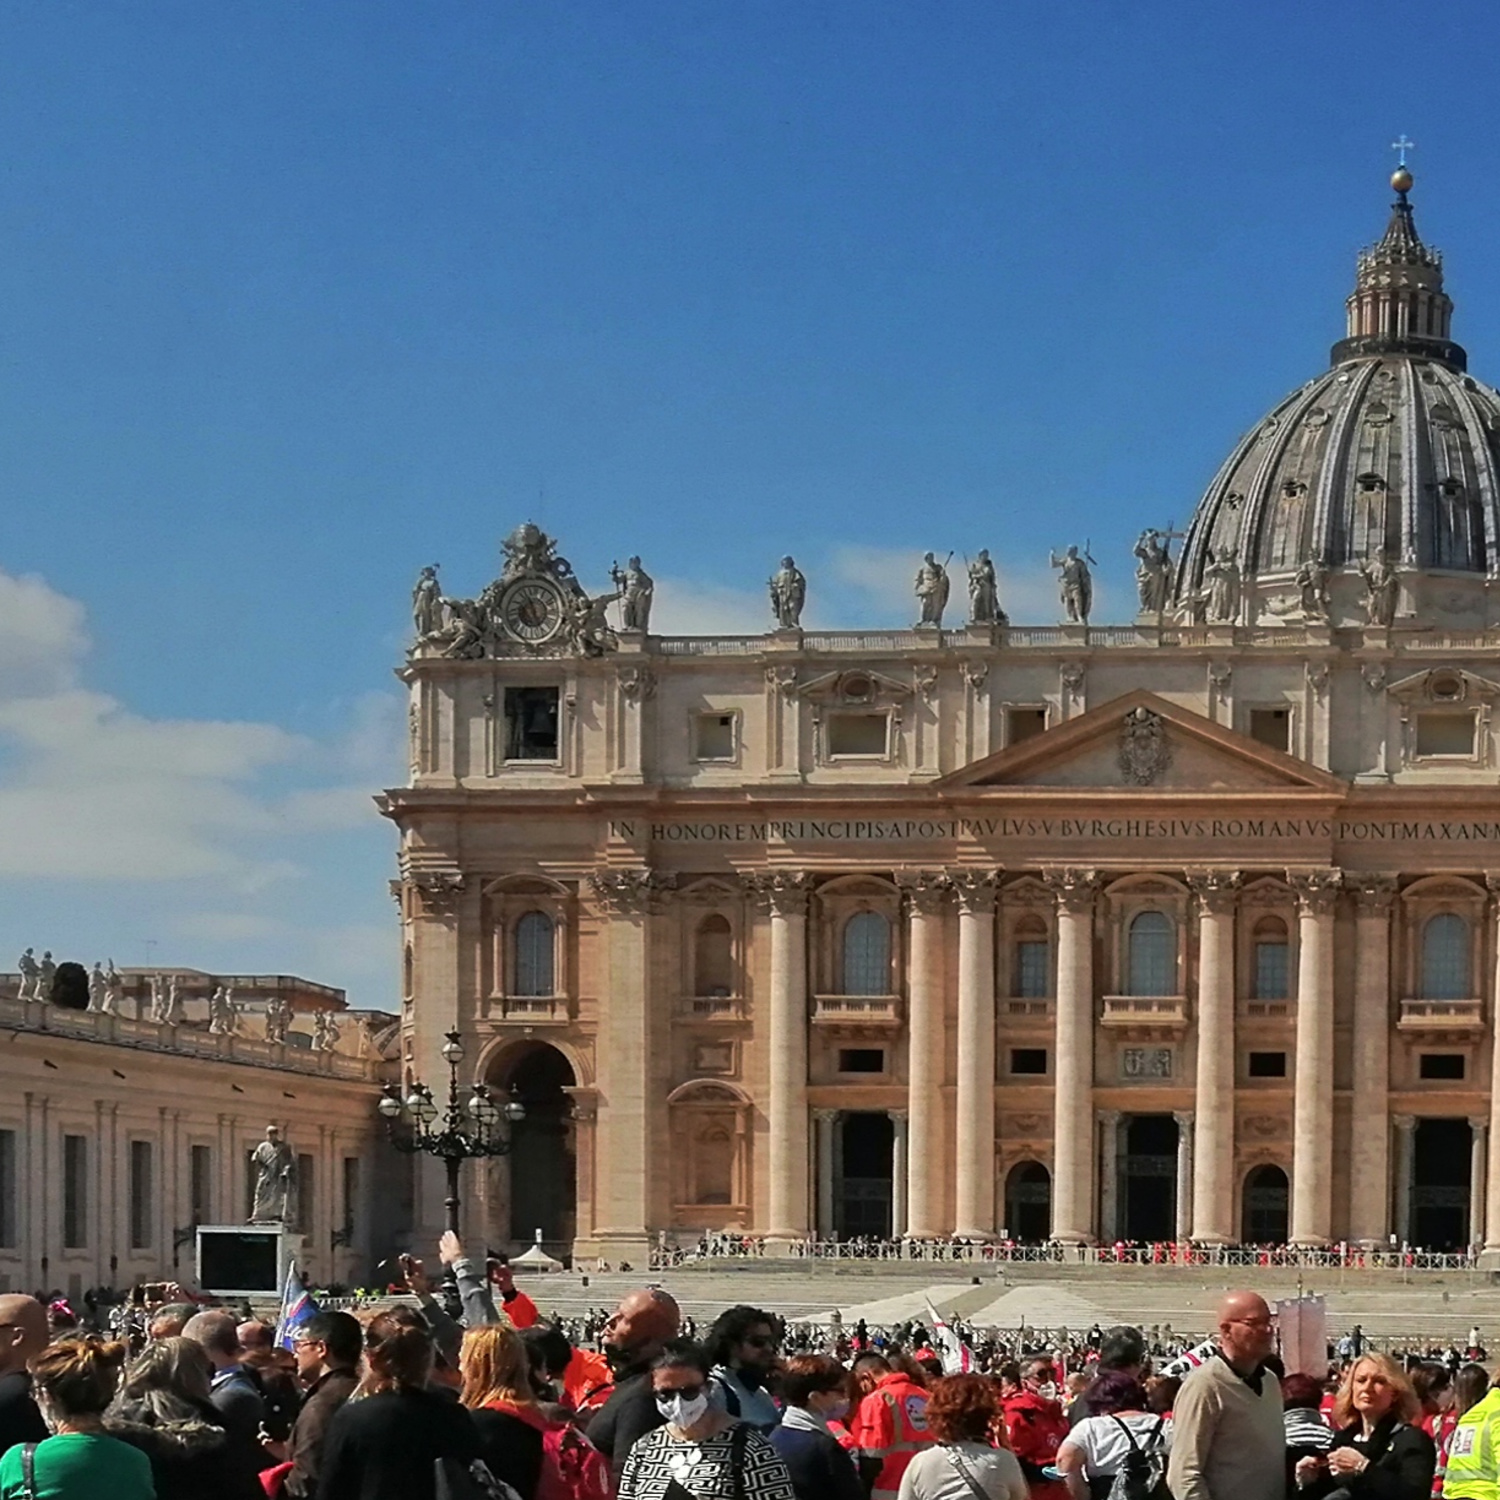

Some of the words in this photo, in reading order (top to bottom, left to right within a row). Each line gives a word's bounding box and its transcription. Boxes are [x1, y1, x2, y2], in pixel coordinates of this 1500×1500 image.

[610, 820, 635, 838] IN
[651, 822, 767, 841] HONOREM
[769, 820, 885, 839] PRINCIPIS
[888, 820, 957, 839] APOST
[960, 818, 1037, 837] PAVLVS
[1061, 819, 1205, 838] BVRGHESIVS
[1211, 819, 1332, 838] ROMANVS
[1339, 821, 1399, 840] PONT
[1400, 821, 1453, 840] MAX
[1455, 821, 1489, 840] AN
